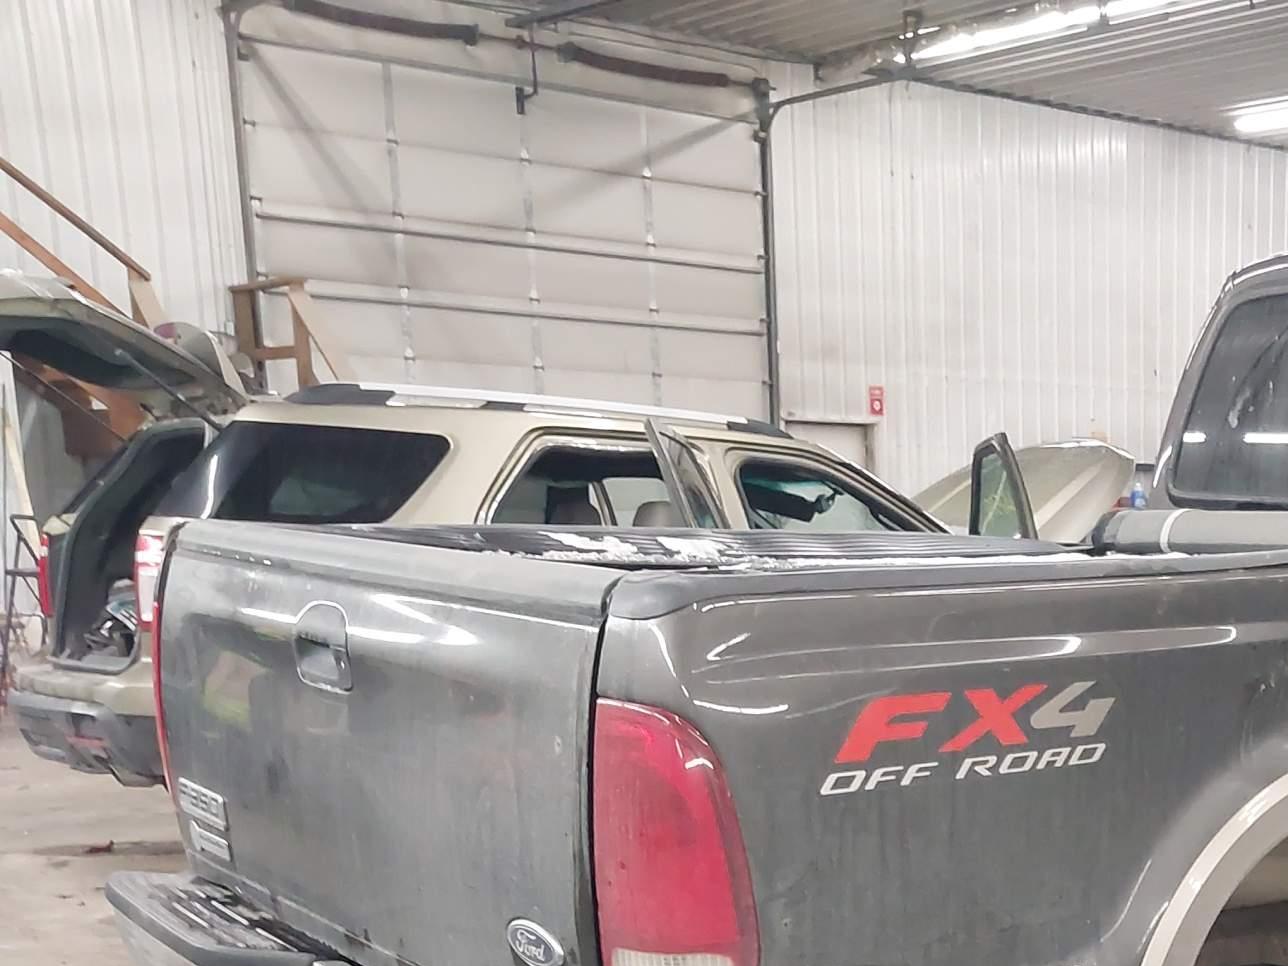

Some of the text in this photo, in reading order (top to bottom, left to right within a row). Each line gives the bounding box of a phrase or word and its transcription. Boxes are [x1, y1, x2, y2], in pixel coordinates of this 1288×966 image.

[834, 680, 1116, 764] FX4
[820, 742, 1107, 796] OFF ROAD
